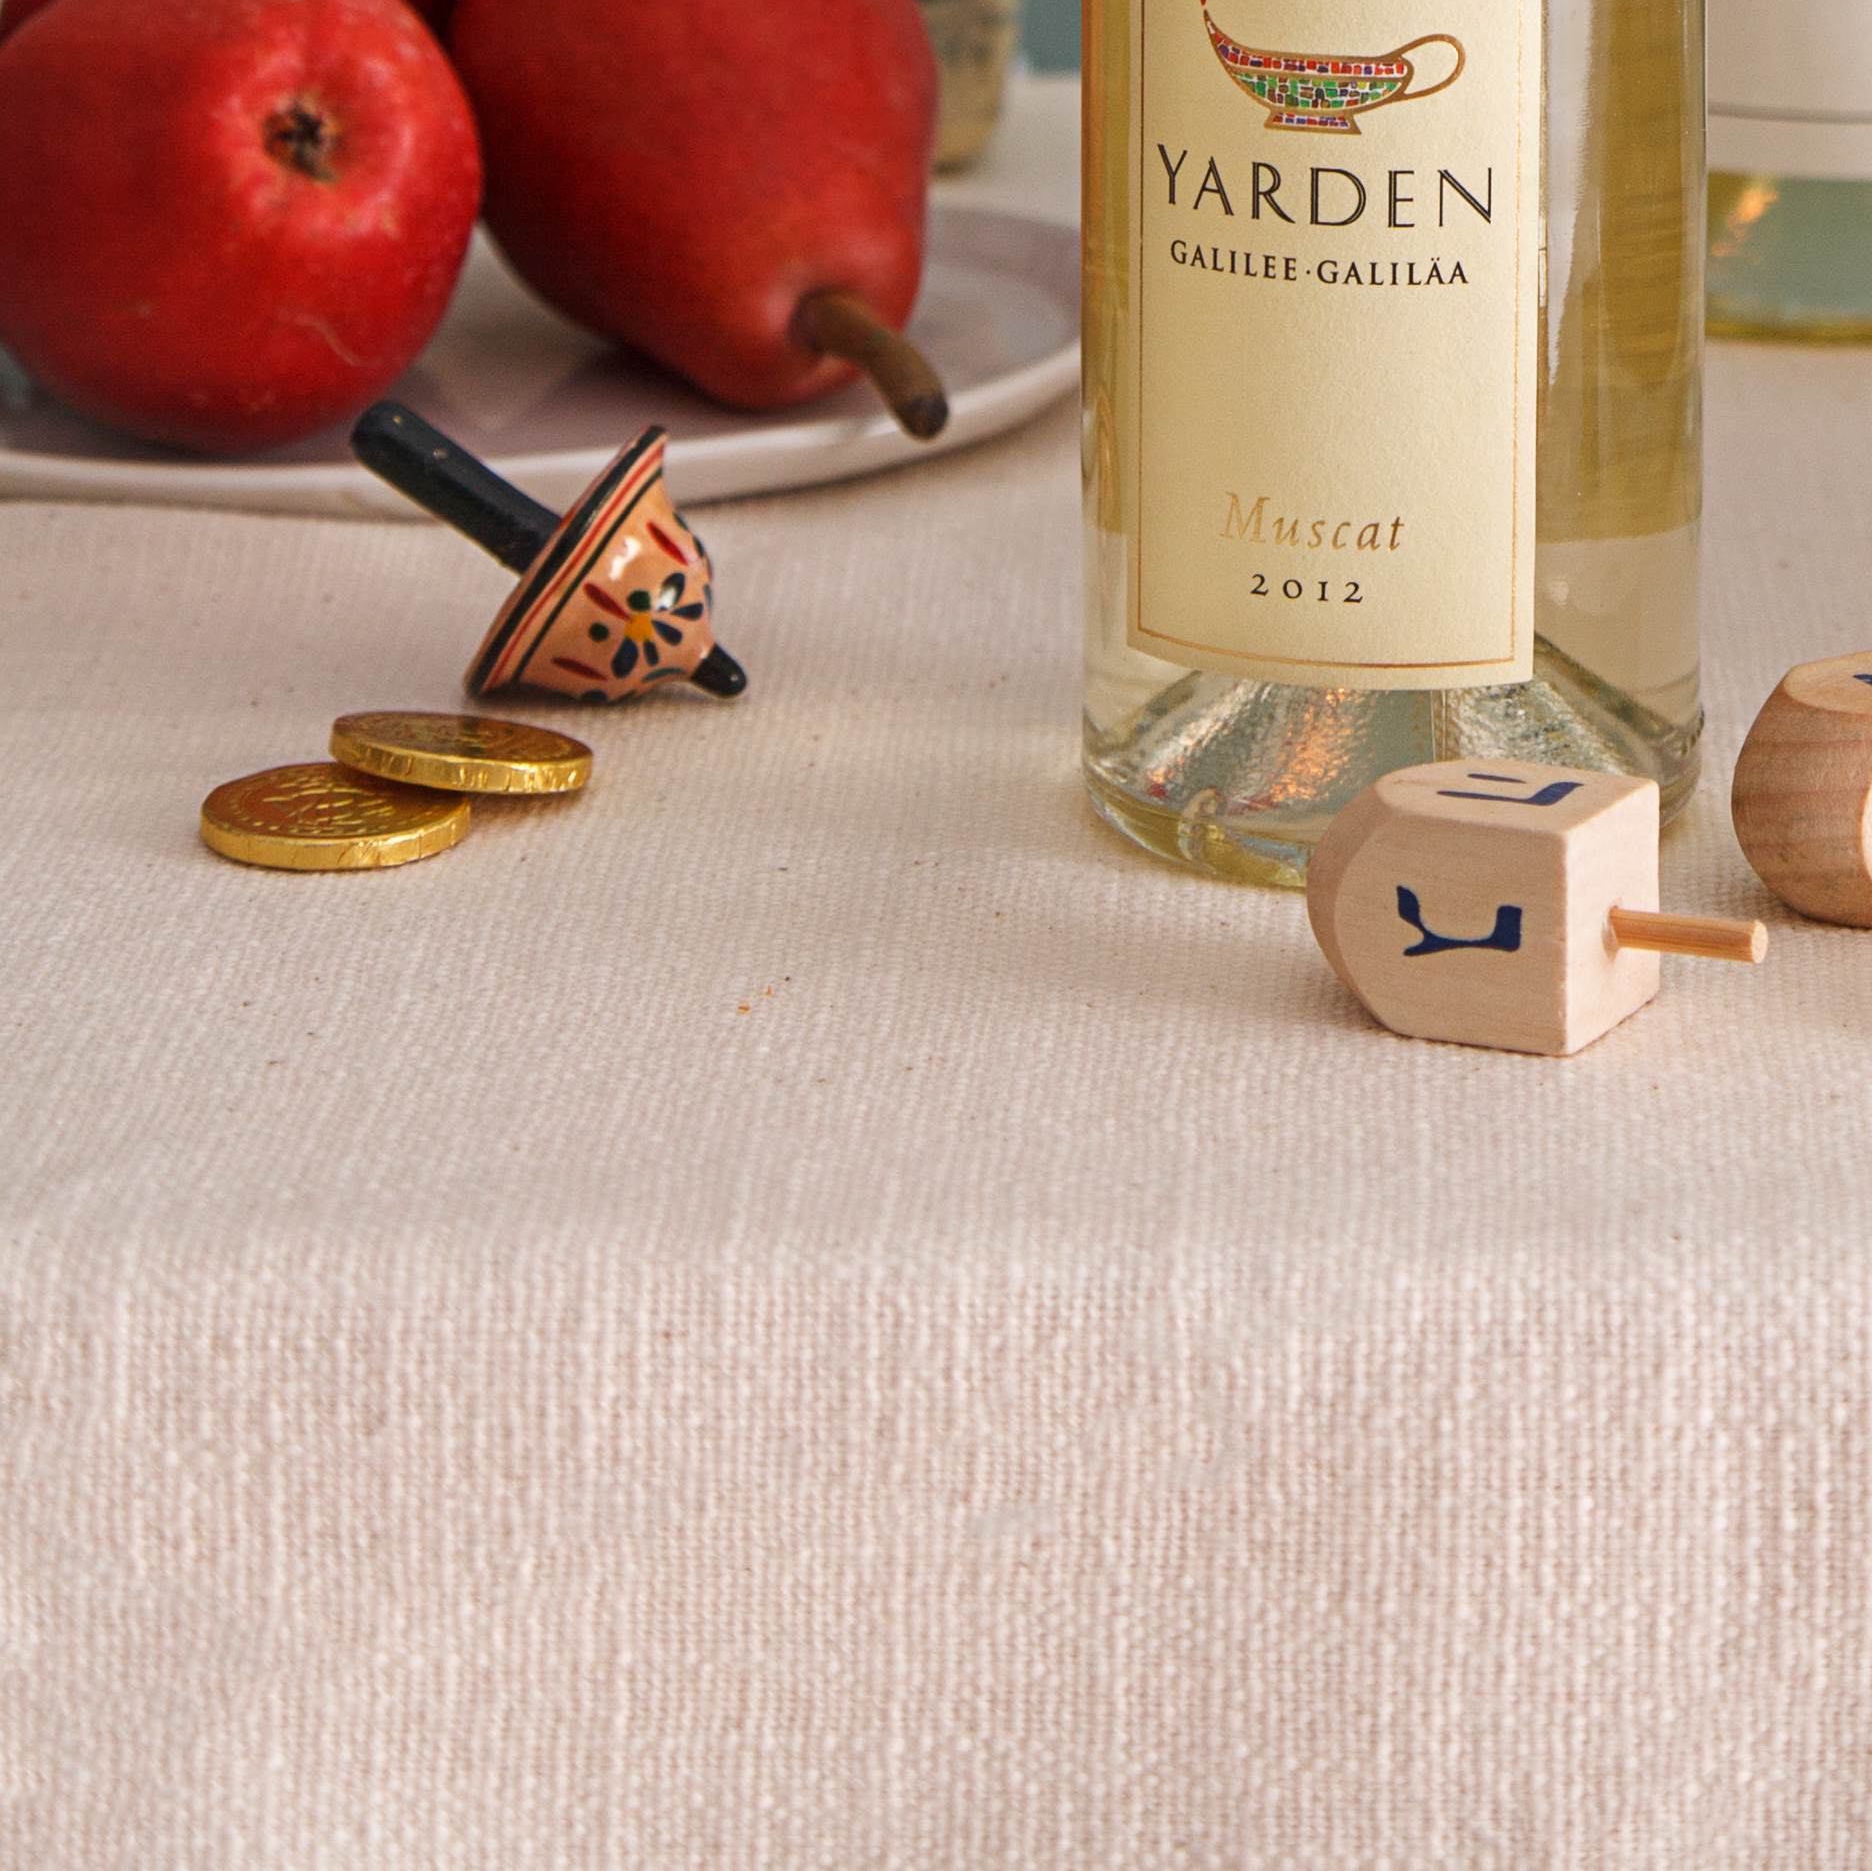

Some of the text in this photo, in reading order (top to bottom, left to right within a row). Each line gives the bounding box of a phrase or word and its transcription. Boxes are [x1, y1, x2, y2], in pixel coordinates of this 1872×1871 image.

[1156, 142, 1493, 229] YARDEN
[1218, 490, 1406, 552] Muscat
[1249, 573, 1364, 604] 2012
